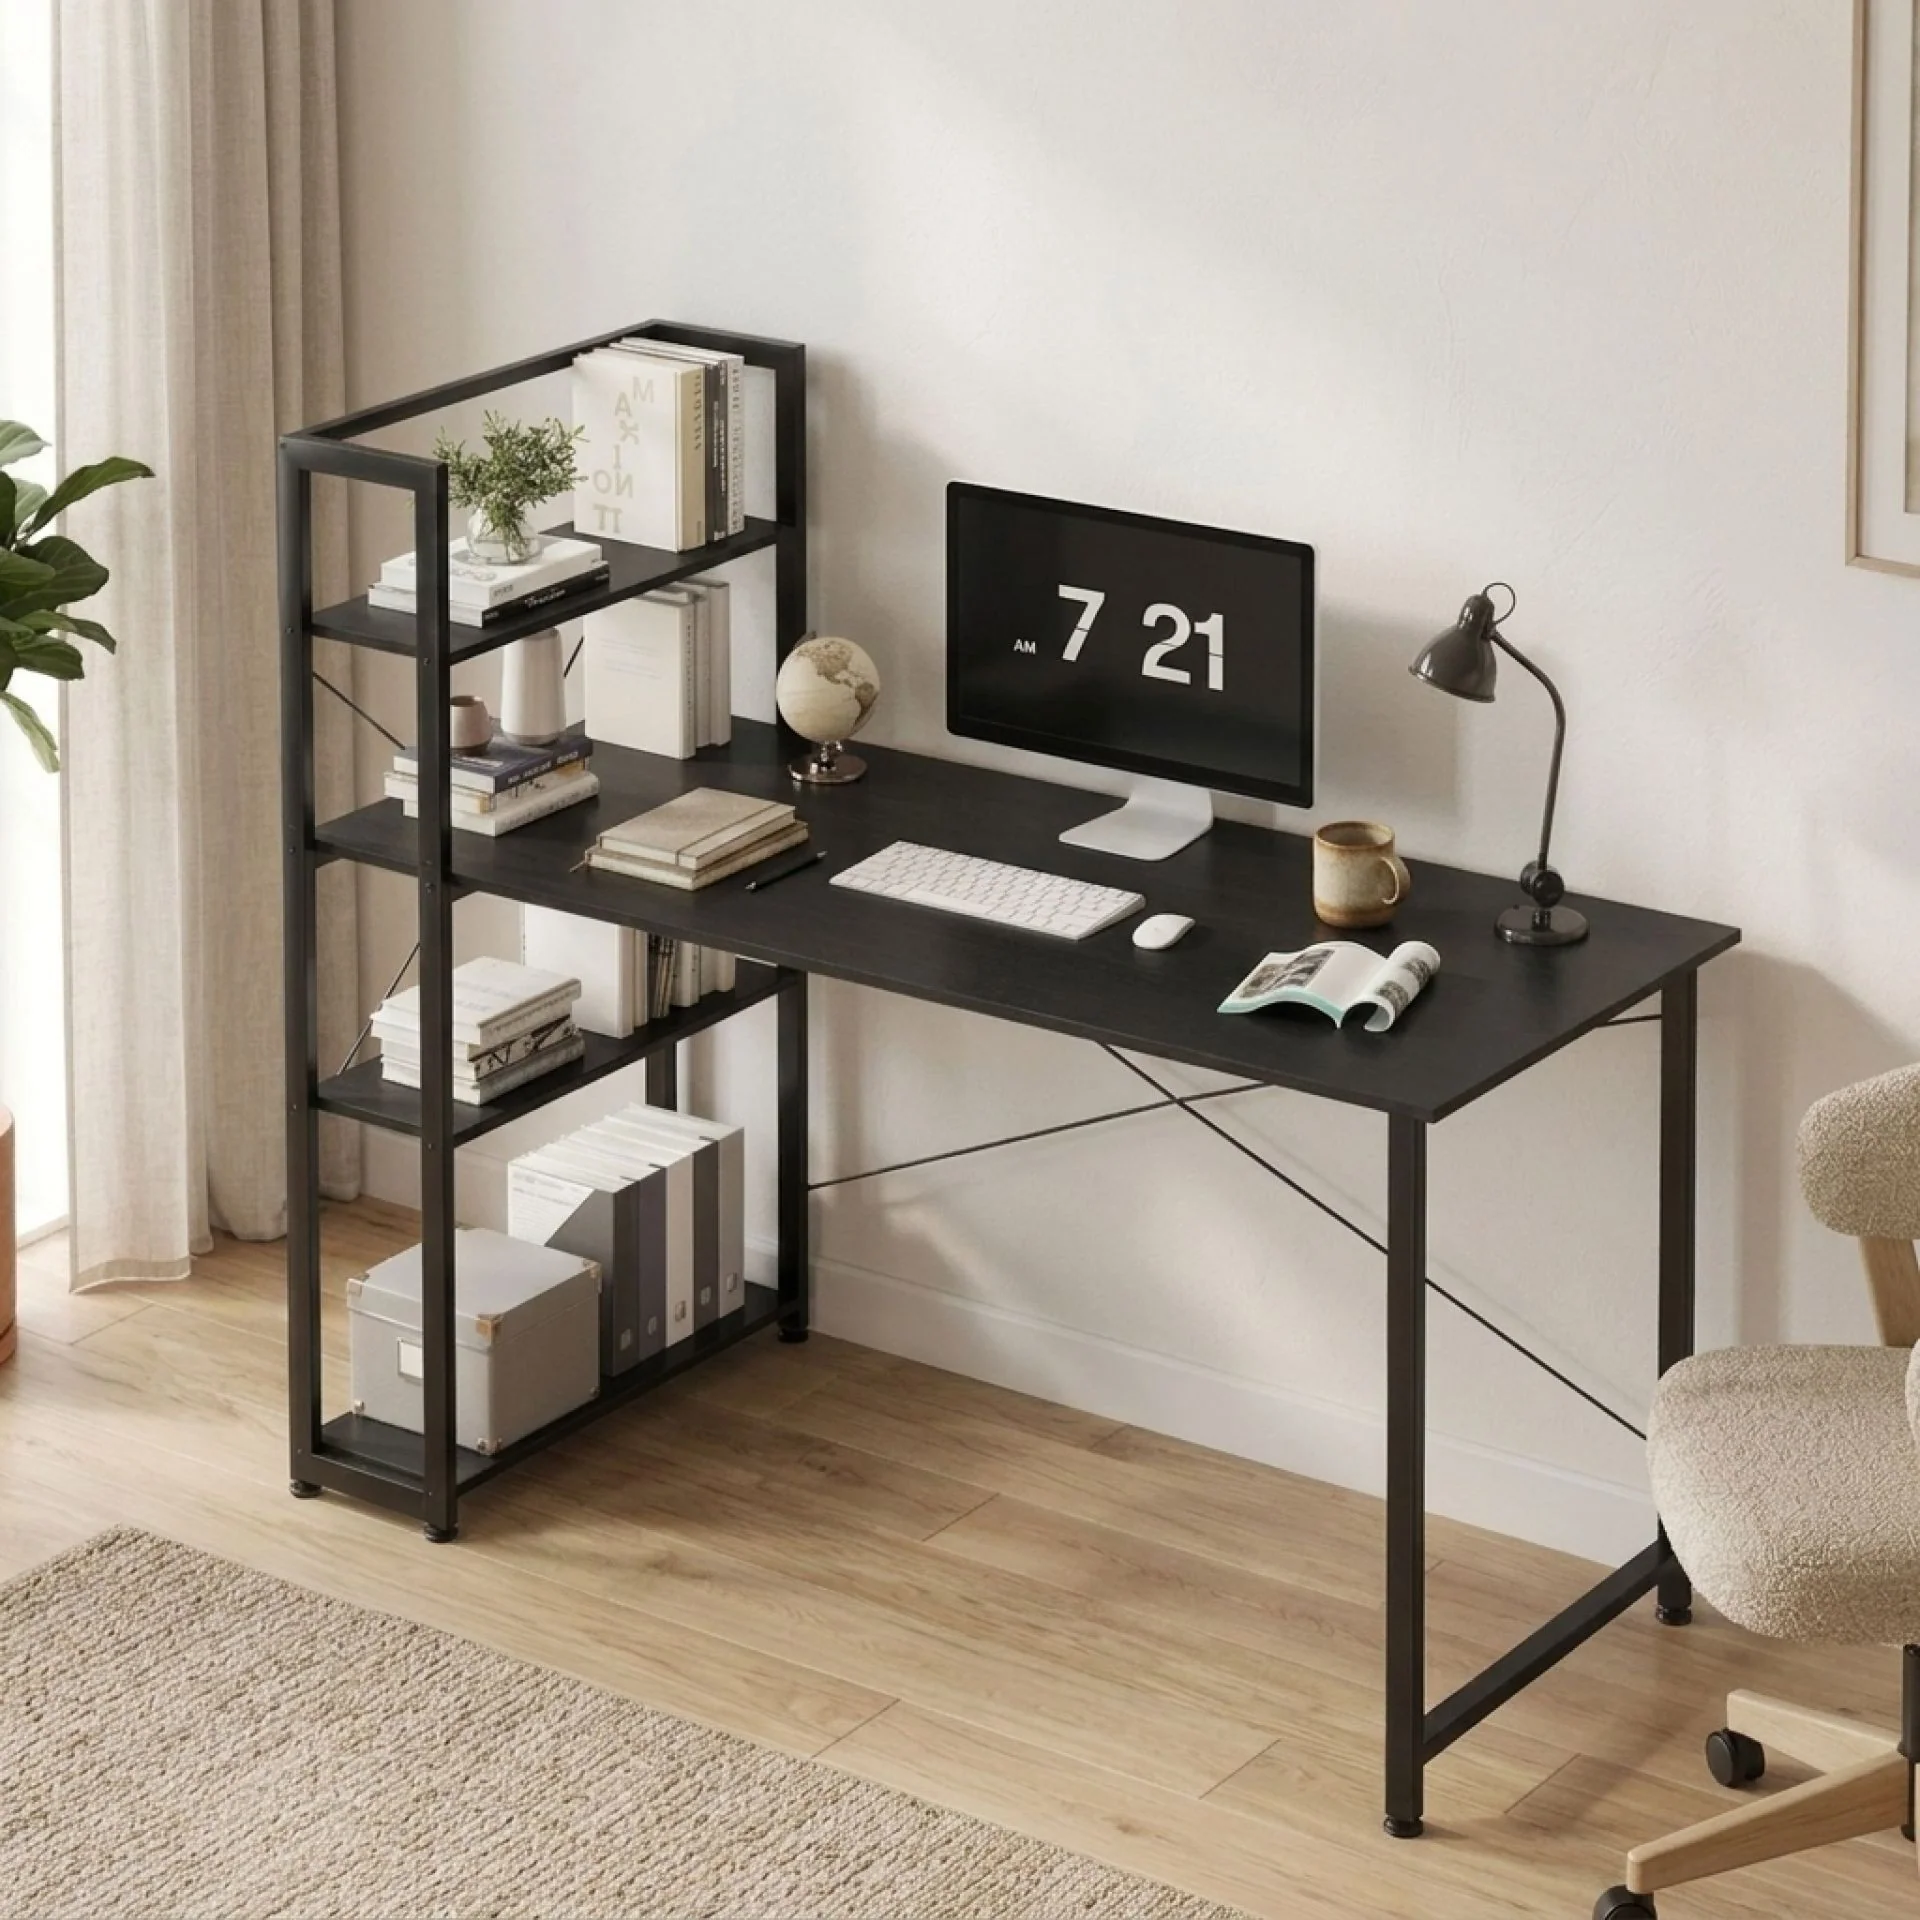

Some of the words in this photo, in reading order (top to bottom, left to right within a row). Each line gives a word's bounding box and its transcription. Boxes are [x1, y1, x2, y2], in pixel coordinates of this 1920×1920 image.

[1013, 638, 1036, 654] AM
[1058, 584, 1105, 662] 7
[1141, 603, 1224, 691] 21
